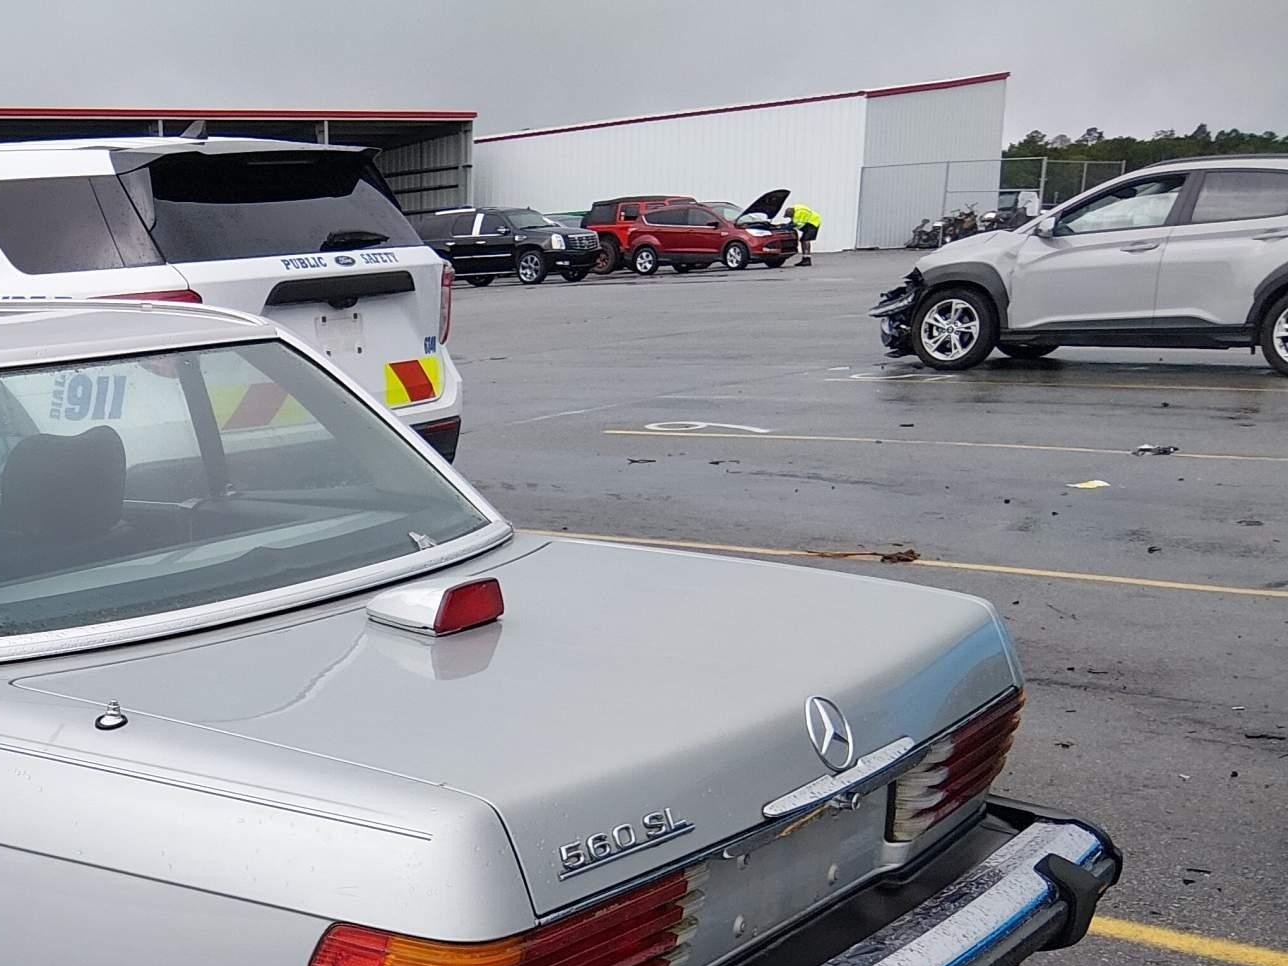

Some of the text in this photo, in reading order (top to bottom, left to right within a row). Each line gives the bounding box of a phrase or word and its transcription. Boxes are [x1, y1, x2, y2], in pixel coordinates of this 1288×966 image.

[280, 256, 328, 271] PUBLIC
[360, 252, 400, 265] SAFETY
[64, 374, 128, 421] 911
[559, 806, 688, 870] 560 SL
